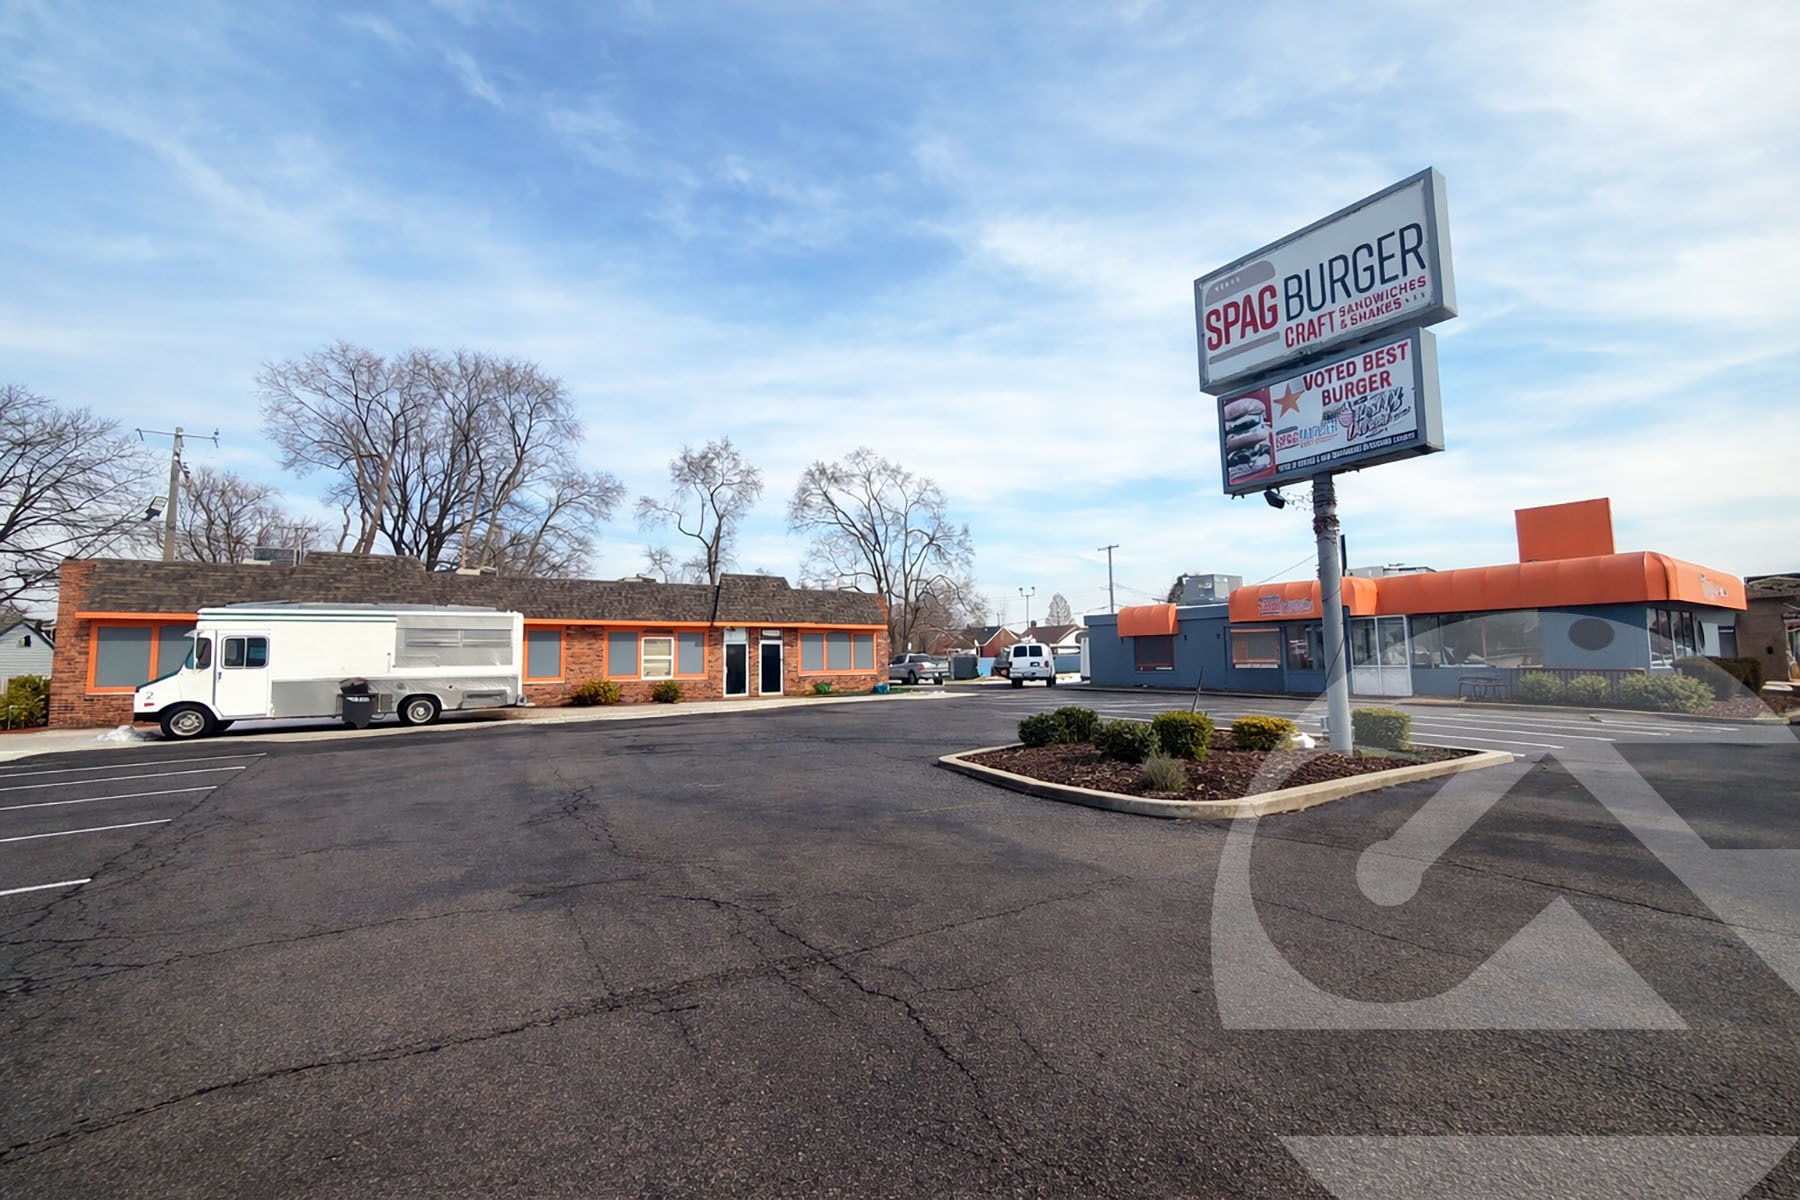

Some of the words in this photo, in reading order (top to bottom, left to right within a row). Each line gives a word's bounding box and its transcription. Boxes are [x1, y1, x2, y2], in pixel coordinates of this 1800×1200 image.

[1205, 284, 1279, 351] SPAG
[1283, 222, 1426, 322] BURGER
[1339, 275, 1427, 317] SANDWICHES
[1284, 310, 1336, 348] CRAFT
[1350, 298, 1402, 326] SHAKES
[1303, 361, 1357, 391] VOTED
[1363, 341, 1409, 372] BEST
[1321, 370, 1392, 407] BURGER
